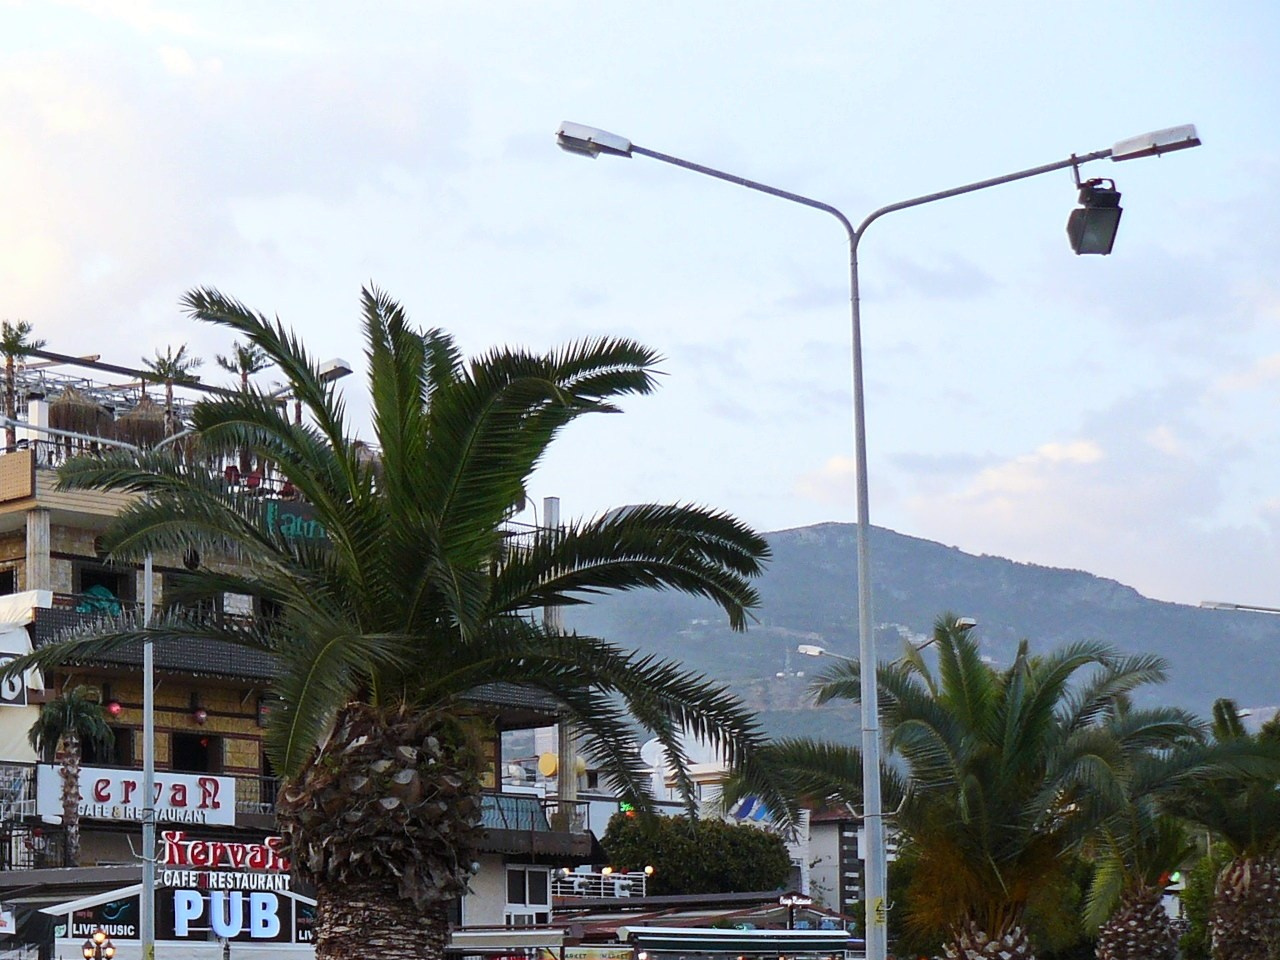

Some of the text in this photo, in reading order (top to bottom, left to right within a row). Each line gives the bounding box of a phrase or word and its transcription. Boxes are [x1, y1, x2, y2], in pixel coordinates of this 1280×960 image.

[78, 804, 110, 817] CAFE
[124, 806, 210, 824] RETAURANT
[163, 870, 198, 887] CAFE
[208, 871, 291, 890] RESTAURANT
[174, 890, 281, 939] PUB
[73, 923, 135, 936] LIVE MUSIC
[299, 930, 313, 940] LIV
